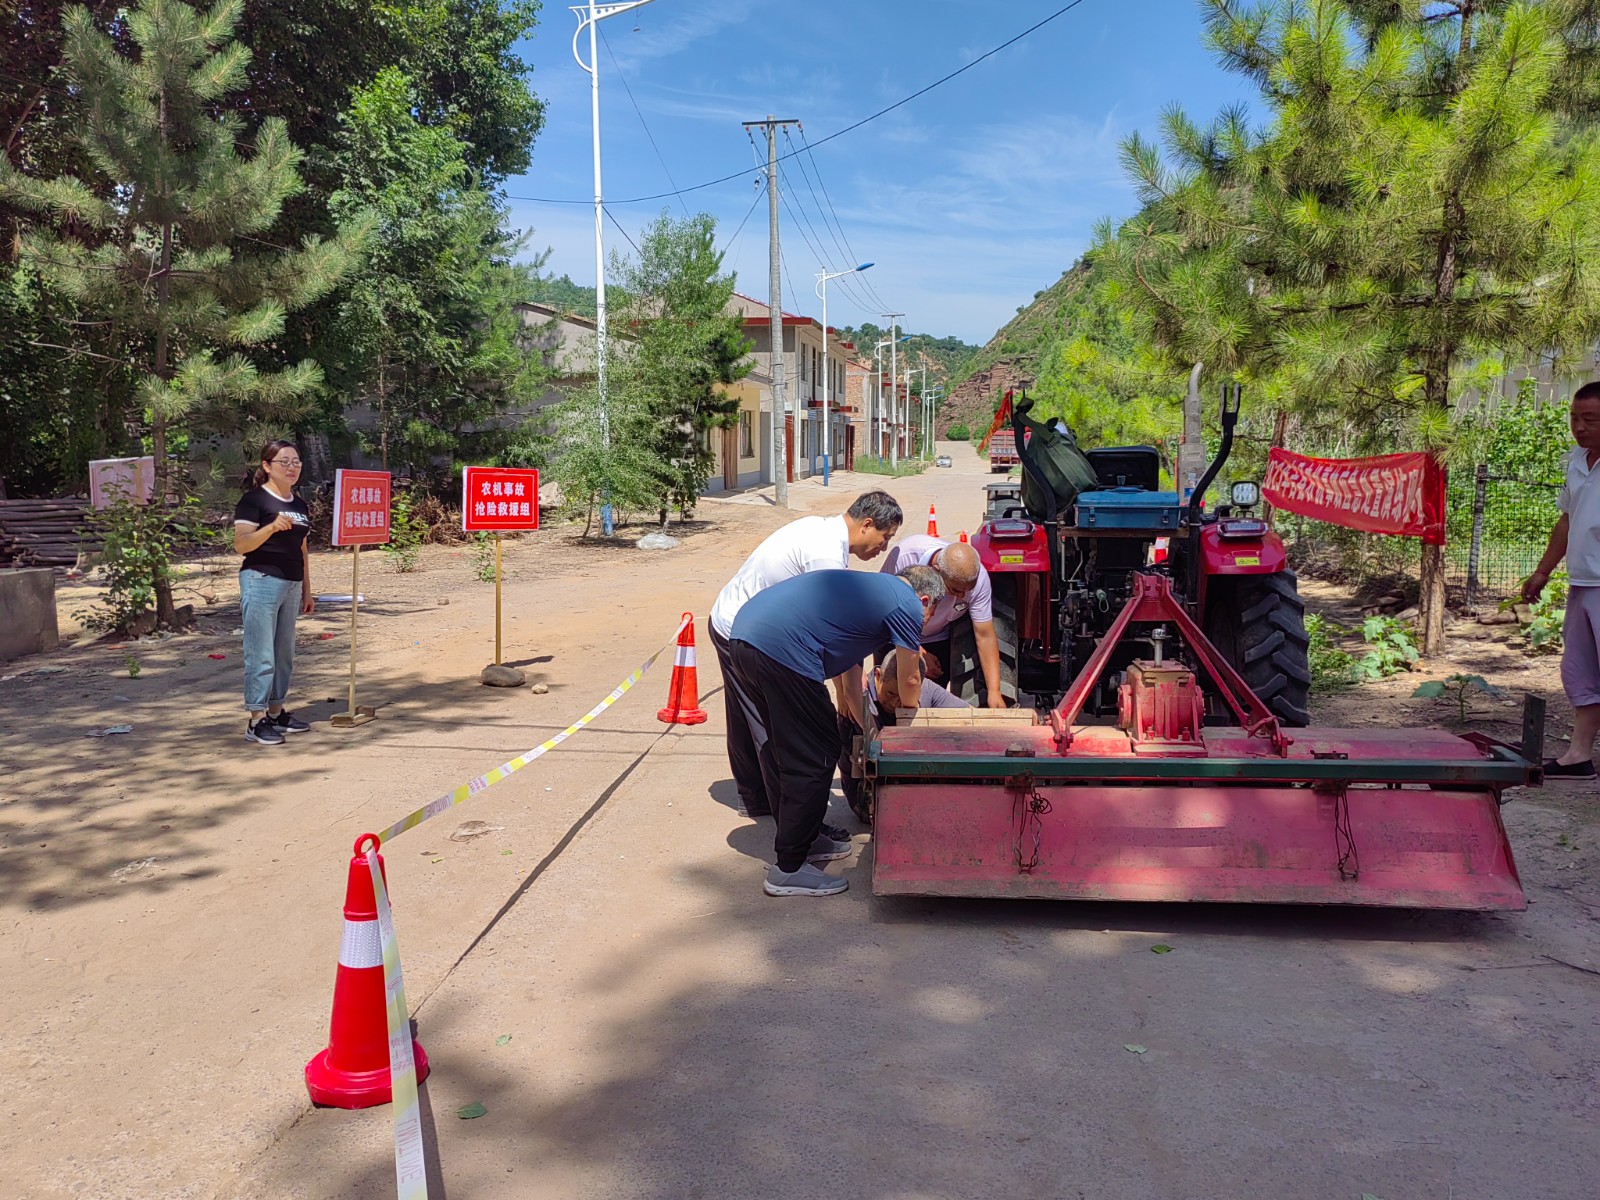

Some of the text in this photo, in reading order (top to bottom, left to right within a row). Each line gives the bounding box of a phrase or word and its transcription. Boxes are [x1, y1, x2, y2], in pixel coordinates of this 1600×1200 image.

[351, 487, 382, 504] 农机事故
[481, 482, 525, 497] 农机事故
[475, 502, 530, 517] 抢险救援组
[345, 511, 385, 528] 现场处置组
